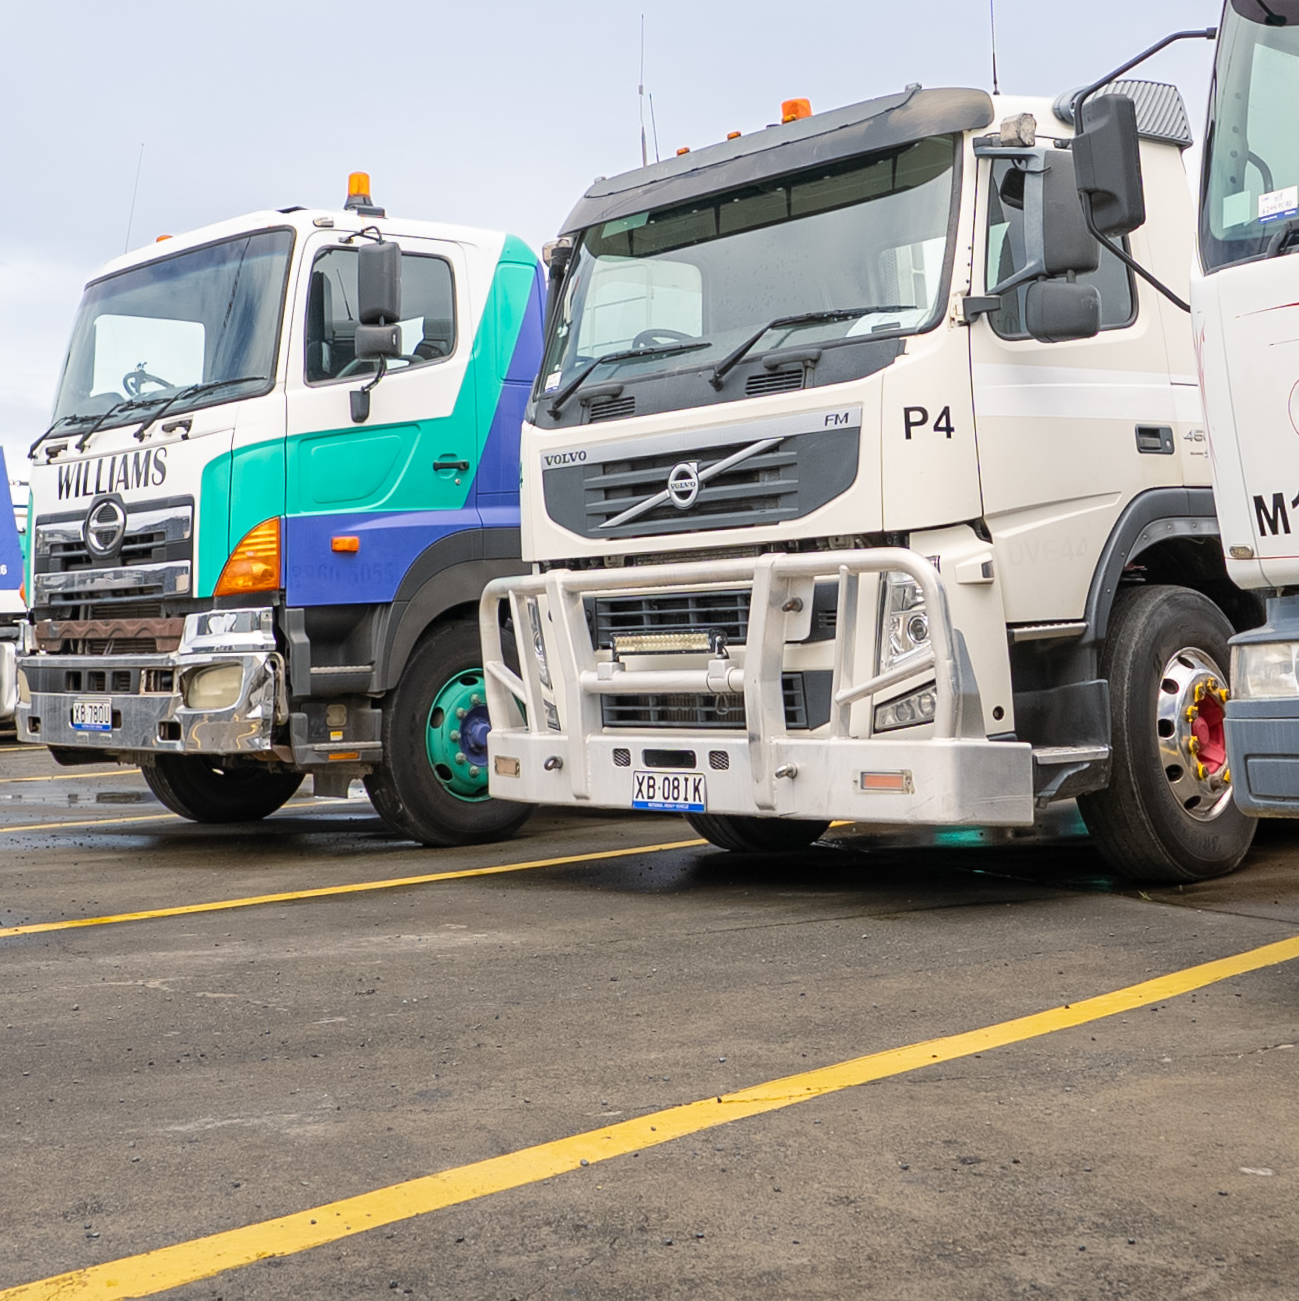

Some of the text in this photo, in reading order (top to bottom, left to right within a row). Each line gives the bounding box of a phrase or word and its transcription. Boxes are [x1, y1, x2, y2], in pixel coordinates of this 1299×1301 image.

[824, 412, 849, 427] FM
[903, 405, 955, 440] P4
[544, 450, 587, 466] VOLVO
[58, 447, 167, 500] WILLIAMS
[670, 481, 696, 489] VOLVO
